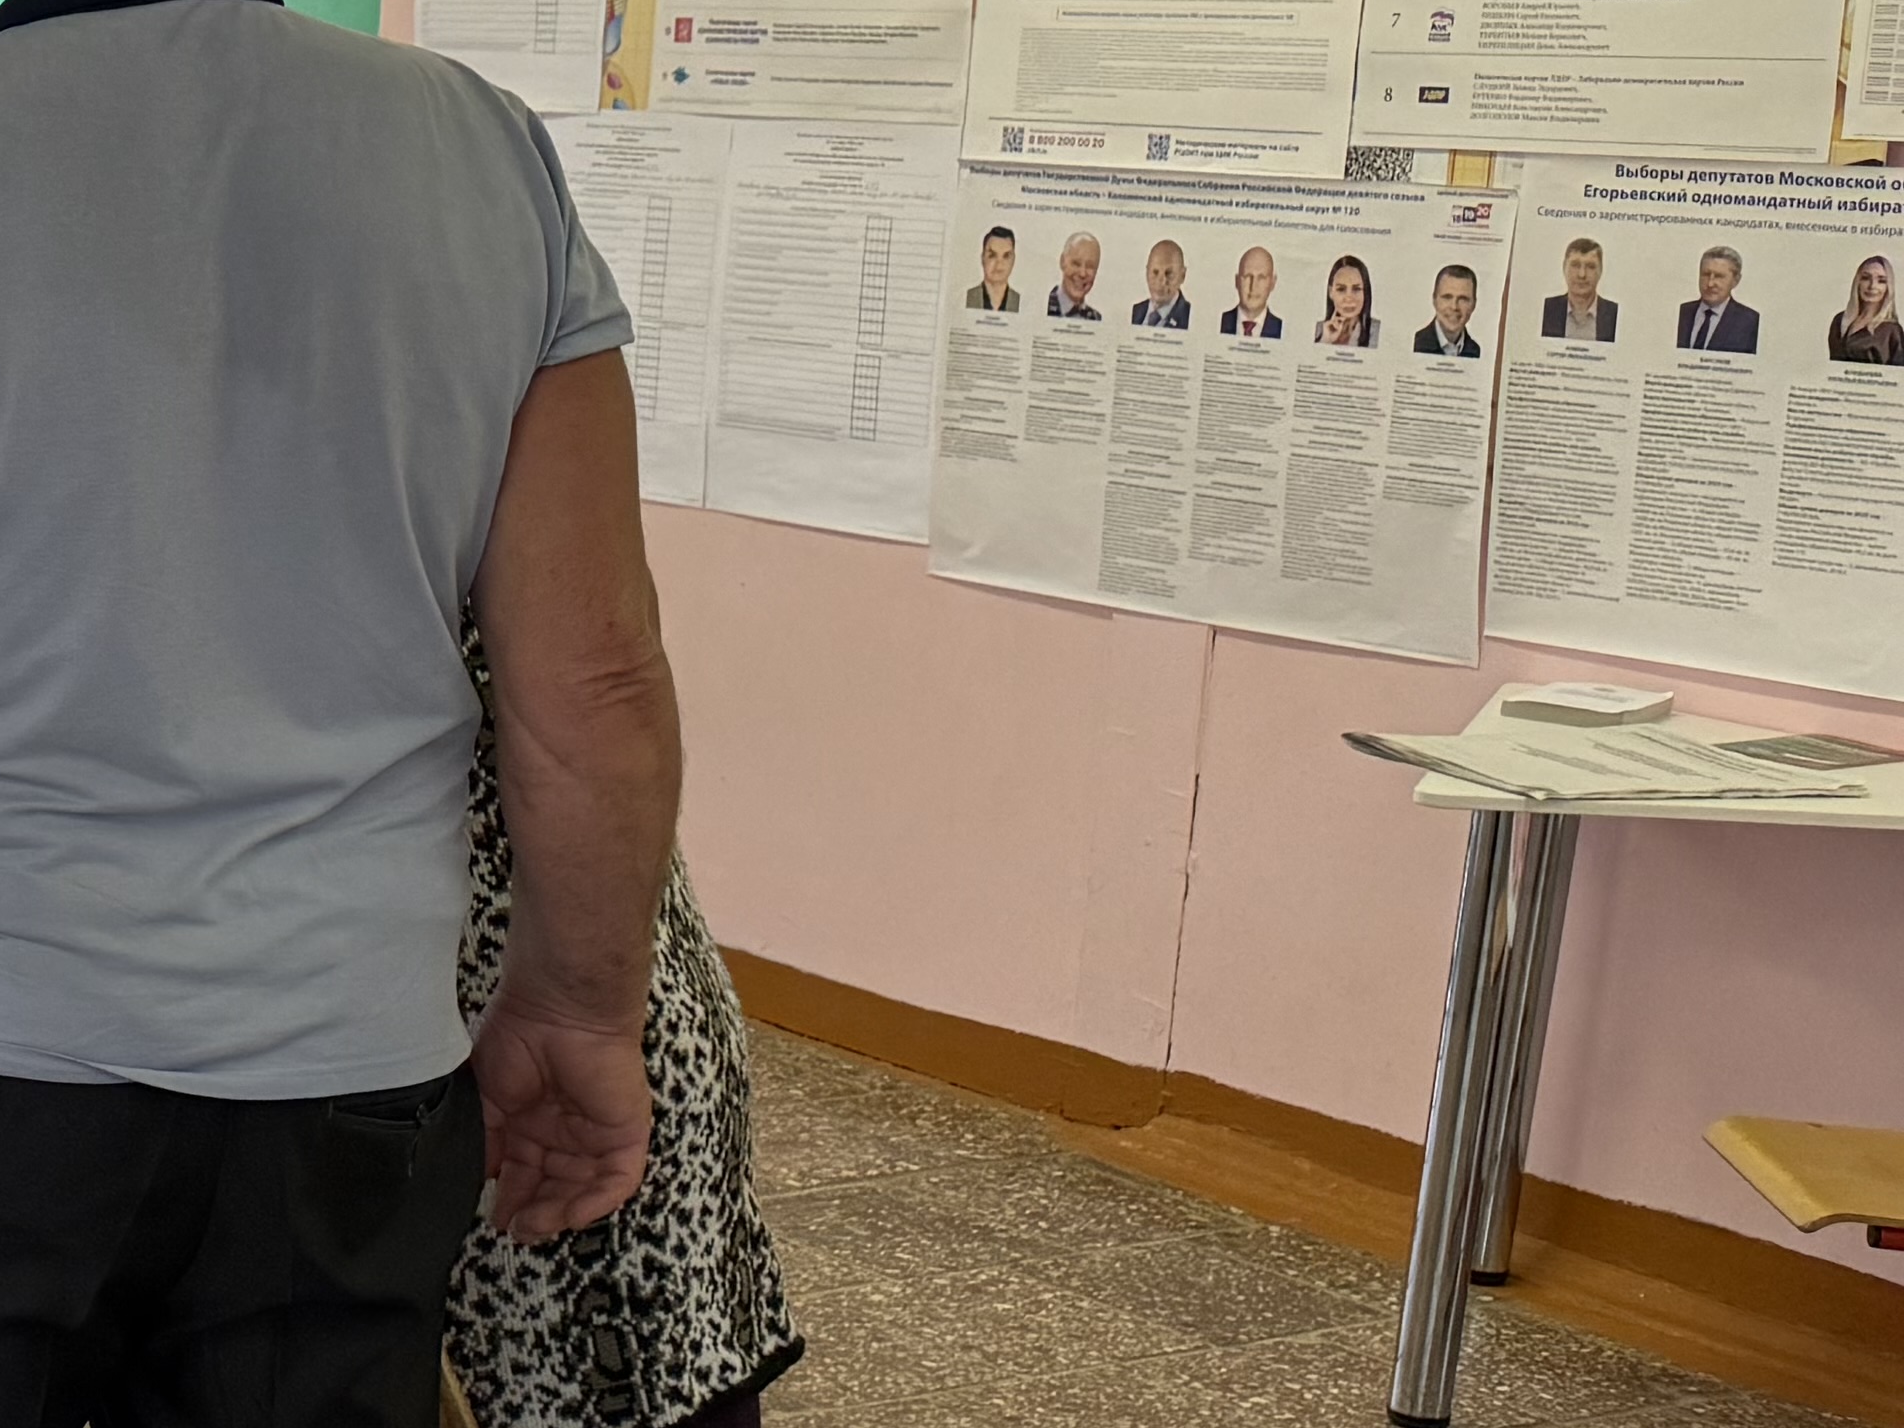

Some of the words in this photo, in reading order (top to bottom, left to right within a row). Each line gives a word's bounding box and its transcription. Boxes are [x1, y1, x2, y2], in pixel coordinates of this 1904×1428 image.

[1392, 12, 1401, 28] 7
[1384, 87, 1393, 102] 8
[1615, 163, 1684, 183] Выборы
[1686, 169, 1775, 186] депутатов
[1779, 171, 1887, 190] Московской
[1583, 184, 1688, 203] Егорьевский
[1691, 192, 1833, 211] одномандатный
[1837, 197, 1904, 217] избира
[1537, 205, 1587, 218] Сведения
[1589, 211, 1597, 219] о
[1599, 211, 1713, 226] зарегистрированных
[1785, 222, 1848, 234] внесенных
[1851, 226, 1858, 234] в
[1860, 223, 1904, 238] избира
